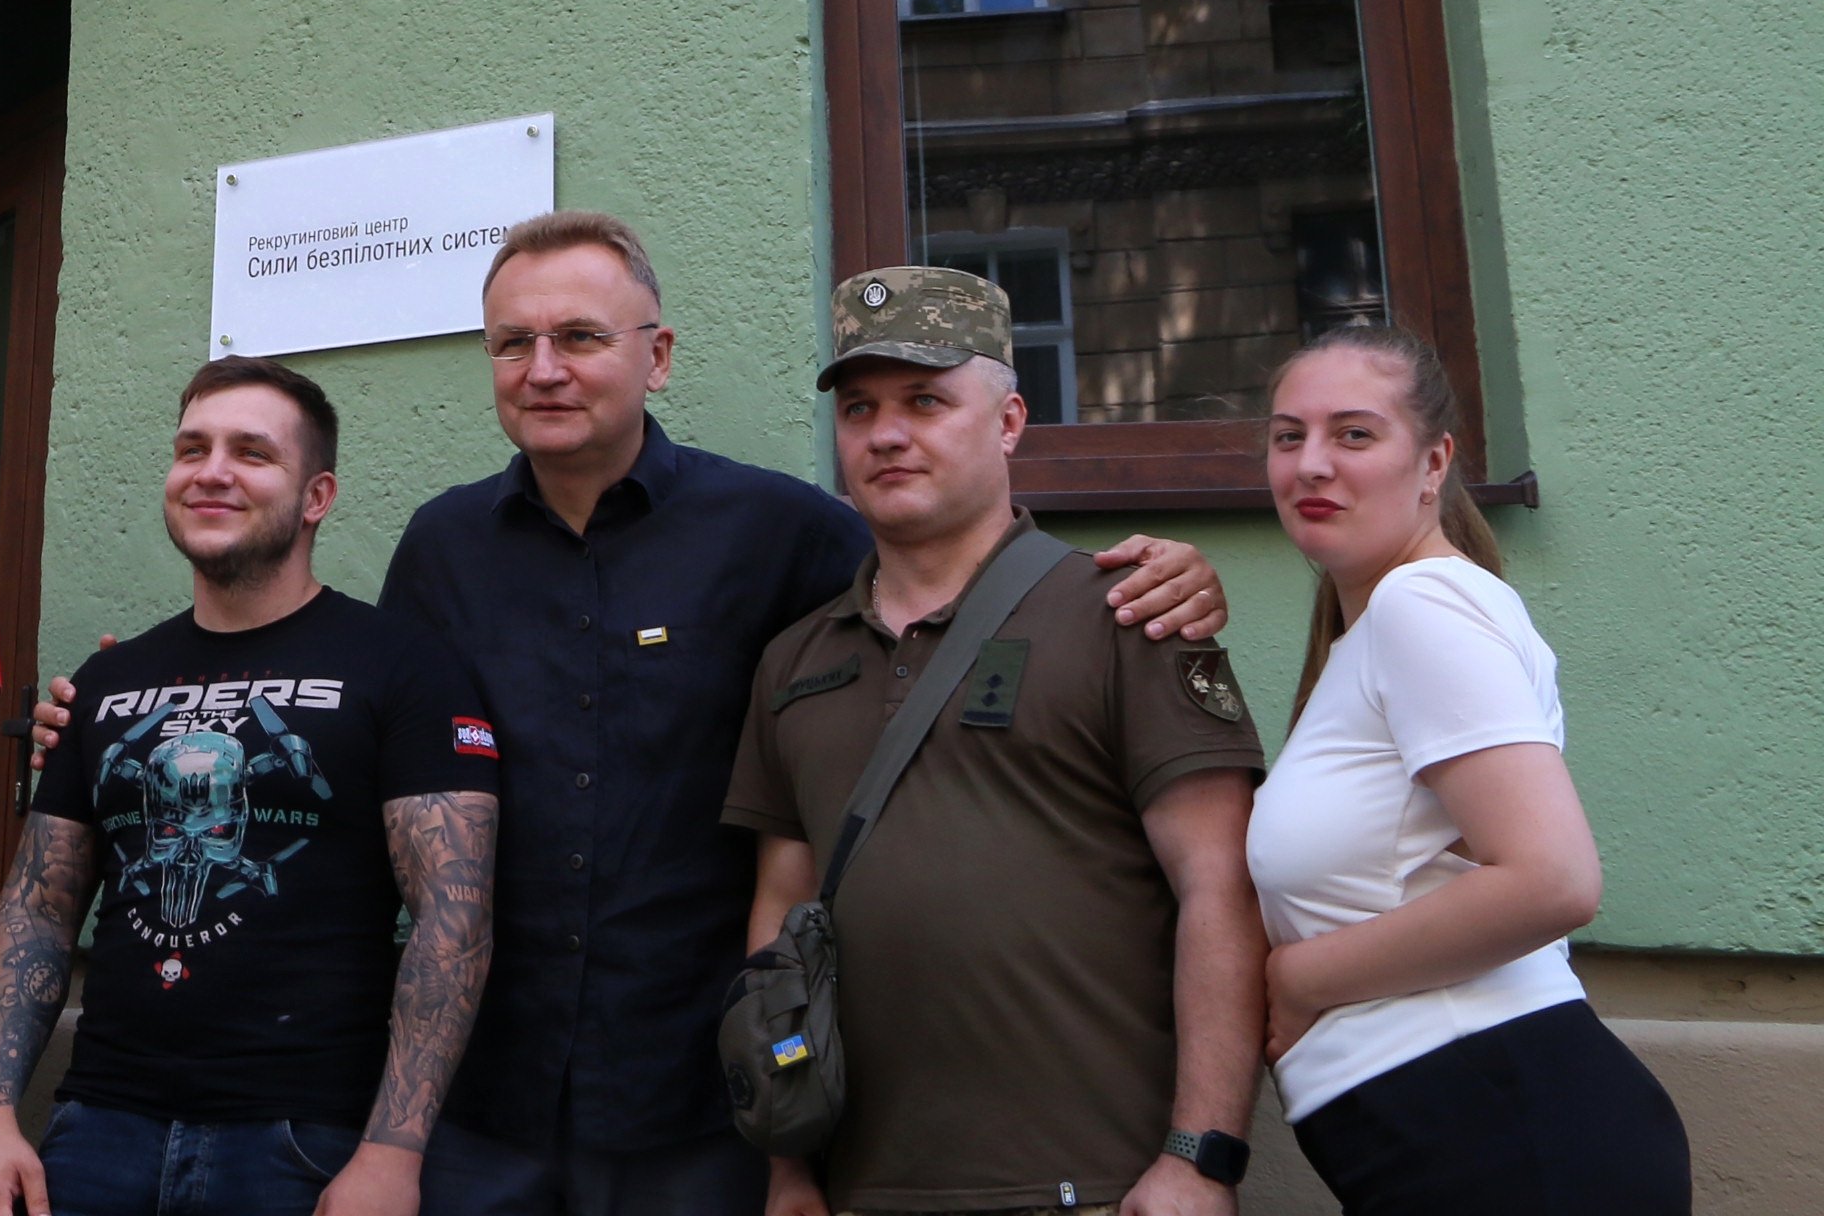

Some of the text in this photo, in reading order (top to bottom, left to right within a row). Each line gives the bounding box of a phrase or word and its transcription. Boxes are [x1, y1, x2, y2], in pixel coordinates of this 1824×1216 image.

[249, 216, 408, 252] Рекрутинговий центр
[248, 256, 298, 278] Сили
[307, 236, 433, 270] безпілотних
[95, 679, 344, 723] RIDERS
[177, 709, 237, 720] IN THE
[160, 716, 250, 737] SKY
[254, 808, 320, 826] WARS
[127, 907, 243, 948] CONQUEROR
